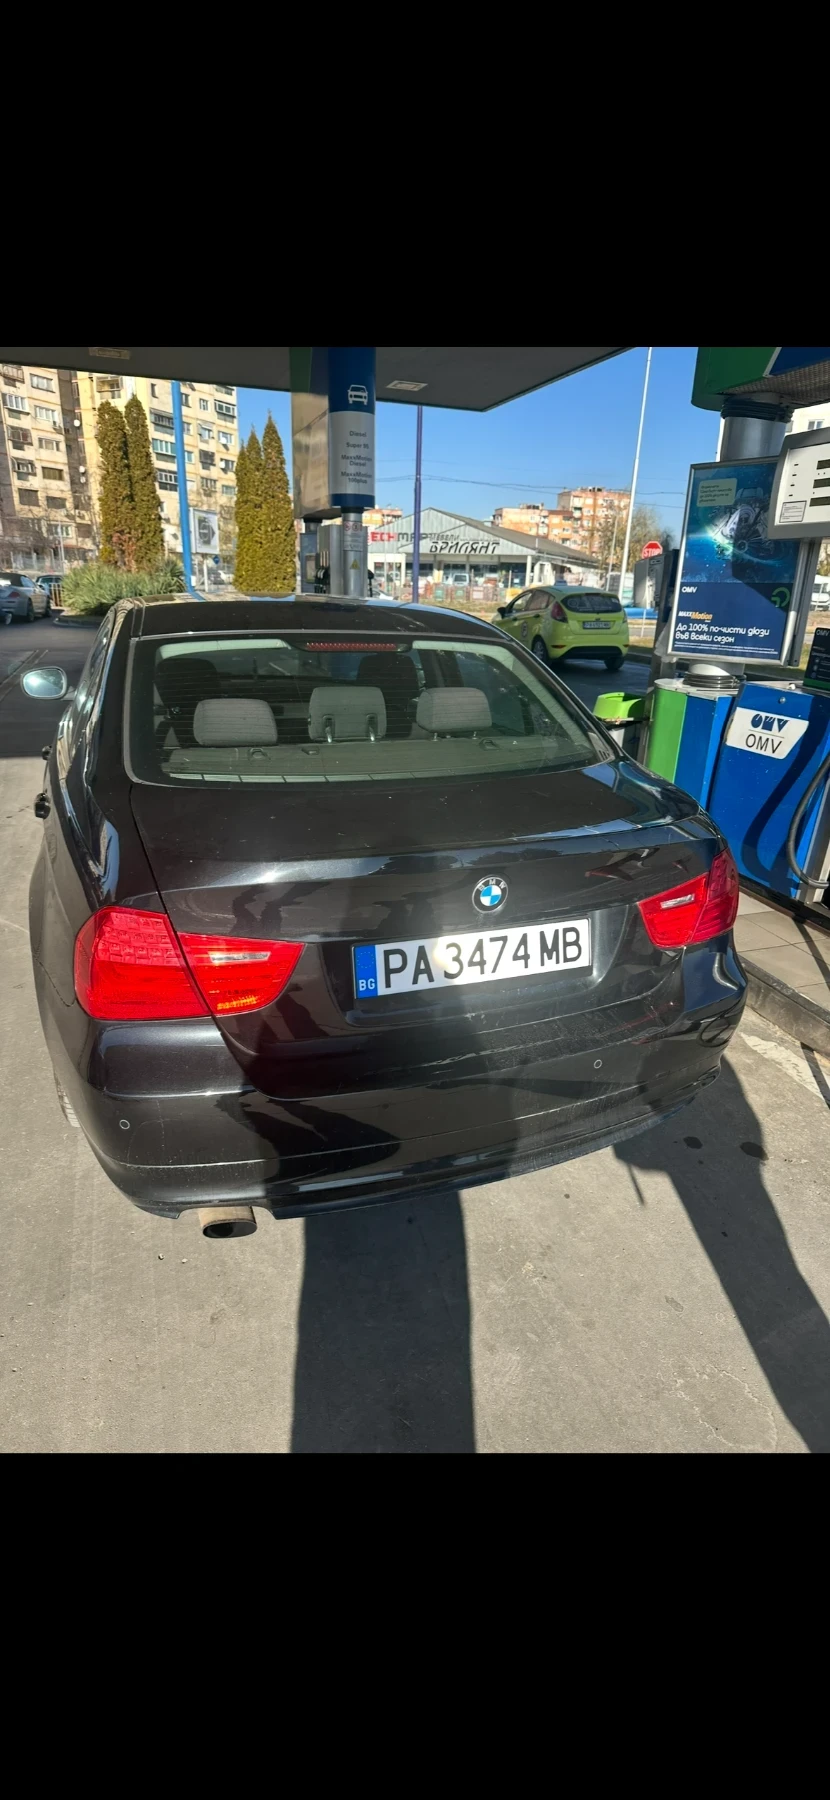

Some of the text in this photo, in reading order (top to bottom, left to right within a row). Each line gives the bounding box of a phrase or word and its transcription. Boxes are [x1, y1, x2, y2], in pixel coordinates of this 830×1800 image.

[429, 541, 500, 554] БРИЛЯНТ
[675, 622, 770, 637] До 100% по-чисти дюзи
[690, 632, 712, 642] всеки
[713, 635, 735, 645] сезон
[751, 713, 790, 733] OMV
[745, 733, 782, 754] OMV
[383, 926, 582, 988] PA 3474 MB
[359, 978, 376, 991] BG
